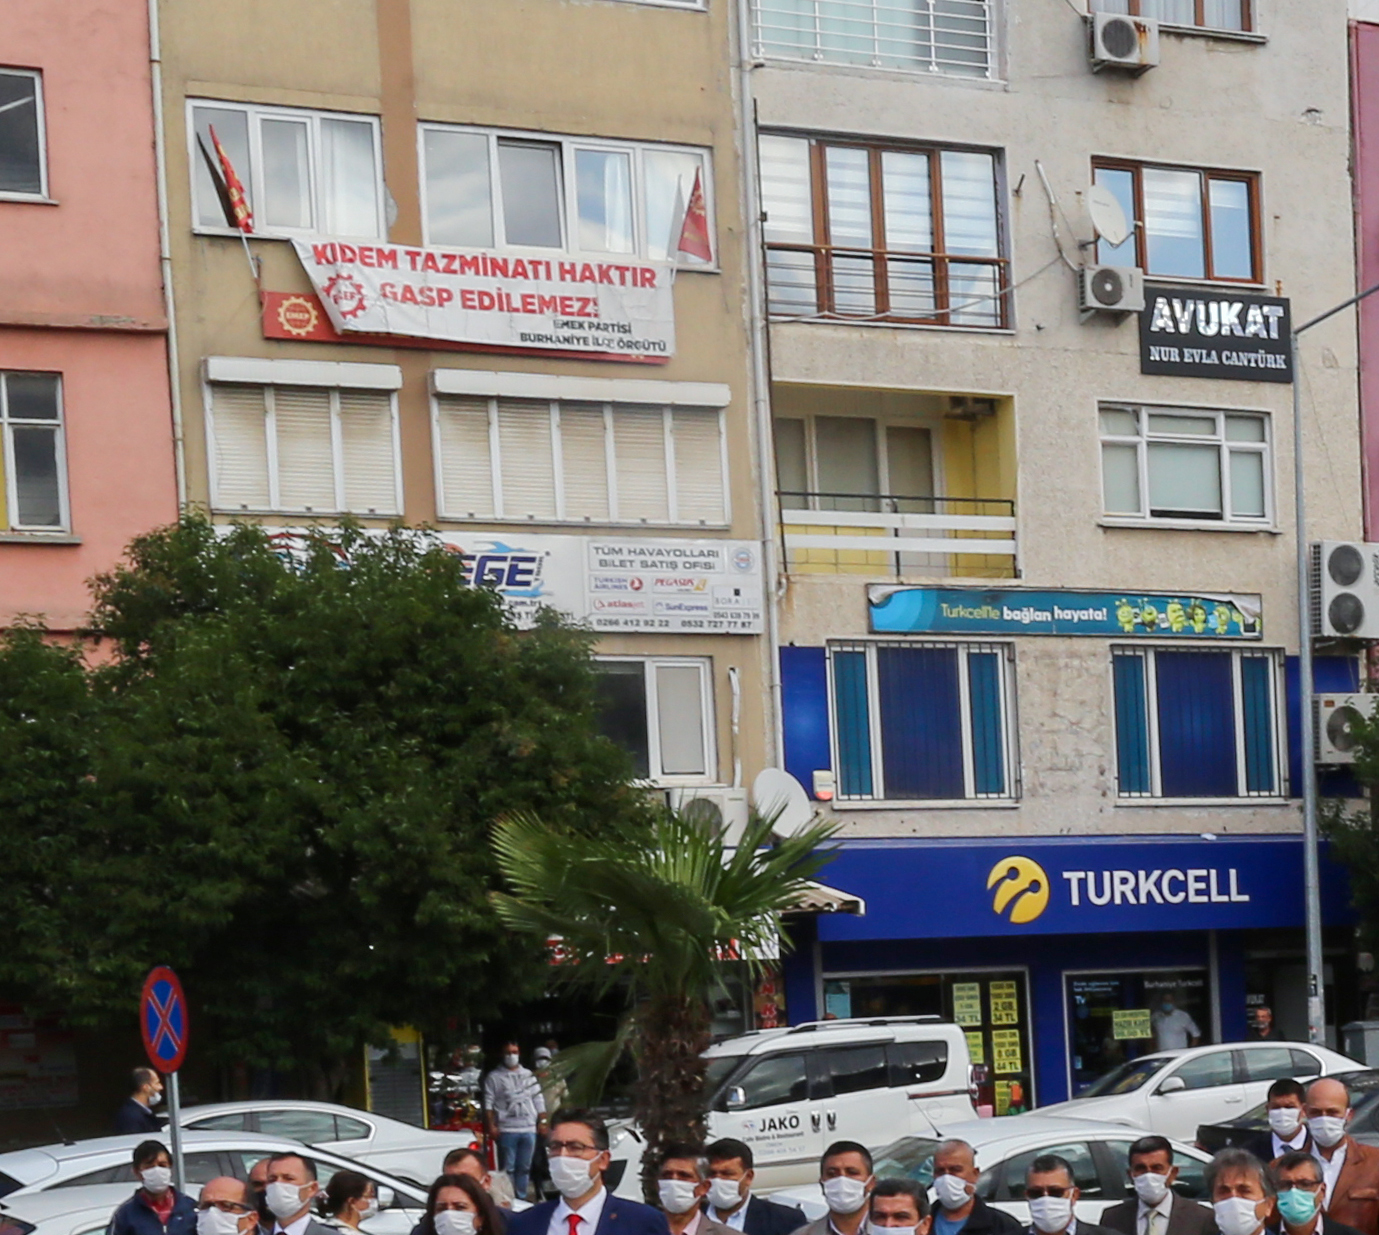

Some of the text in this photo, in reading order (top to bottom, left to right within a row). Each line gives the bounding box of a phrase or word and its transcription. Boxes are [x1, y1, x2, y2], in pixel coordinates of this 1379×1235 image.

[312, 242, 657, 289] KIDEM TAZMİNATI HAKTIR
[379, 282, 452, 308] GASP
[1150, 297, 1285, 340] AVUKAT
[1150, 346, 1286, 369] NUR EVLA CANTÜRK
[593, 545, 719, 558] TÜM HAVAYOLLARI
[1003, 605, 1051, 622] bağlan
[1053, 605, 1107, 623] hayata!
[1062, 868, 1250, 905] TURKCELL
[759, 1115, 800, 1132] JAKO
